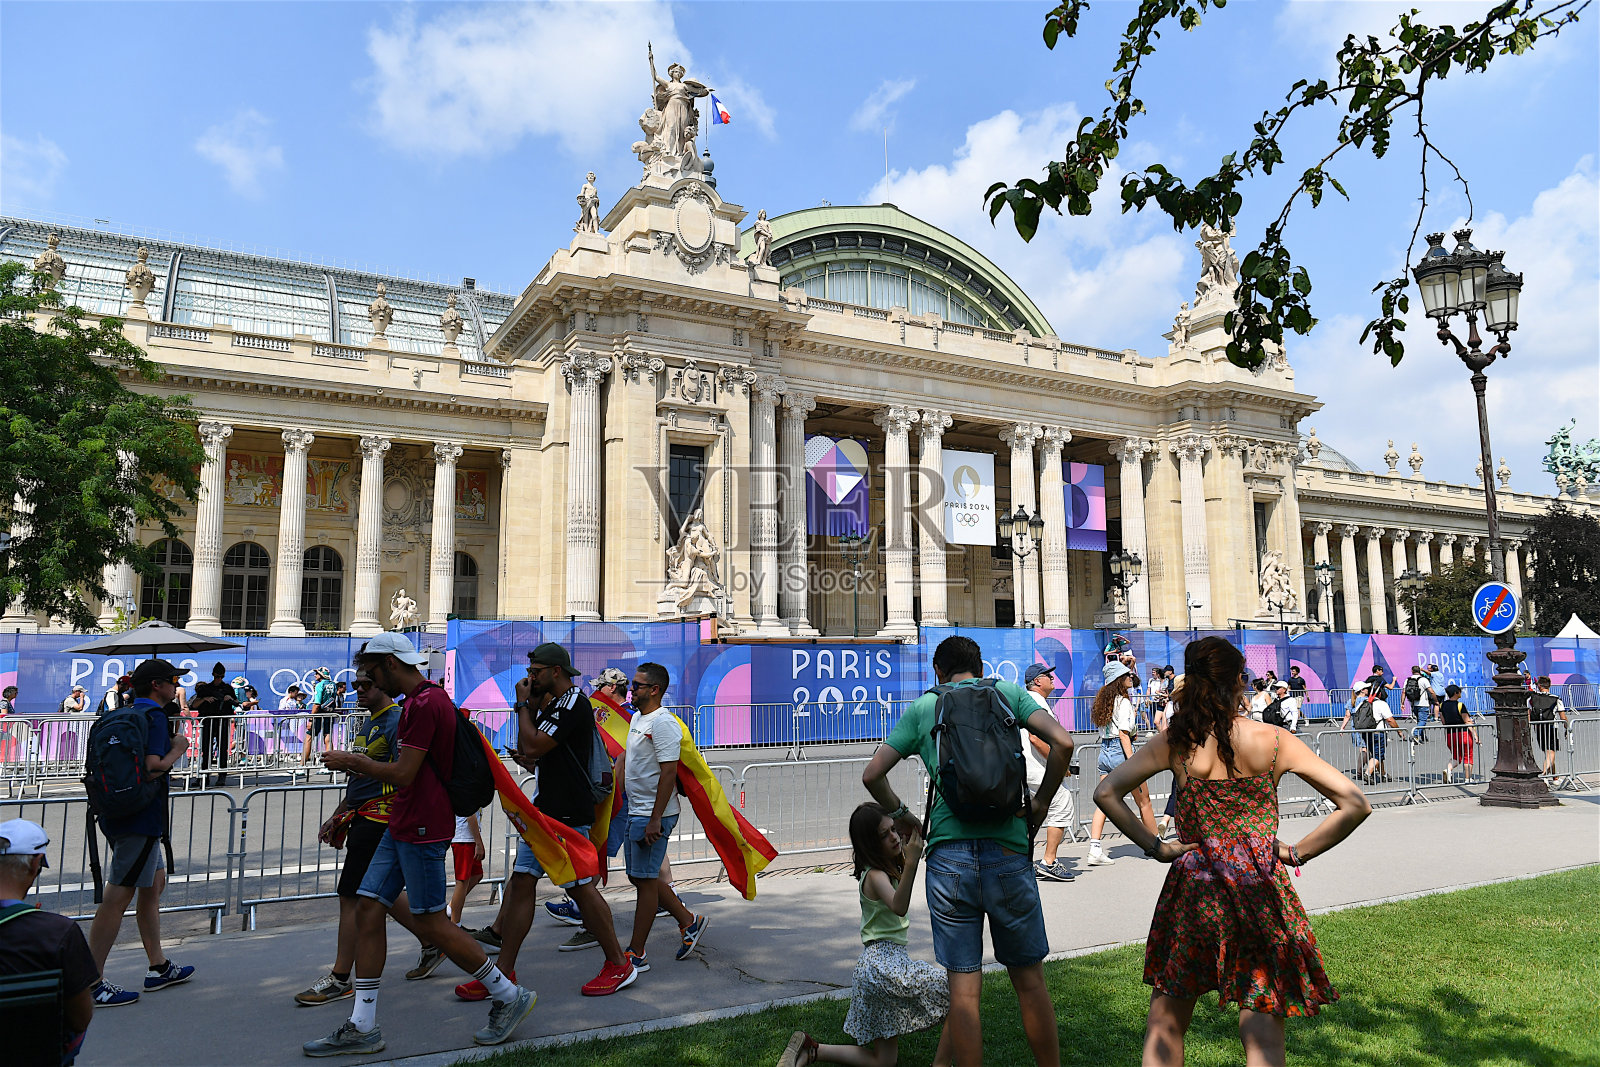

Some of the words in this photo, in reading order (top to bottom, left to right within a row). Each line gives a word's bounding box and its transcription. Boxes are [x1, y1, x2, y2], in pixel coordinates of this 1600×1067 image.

[969, 503, 990, 511] 2024
[447, 666, 451, 683] 5
[792, 685, 893, 717] 2024
